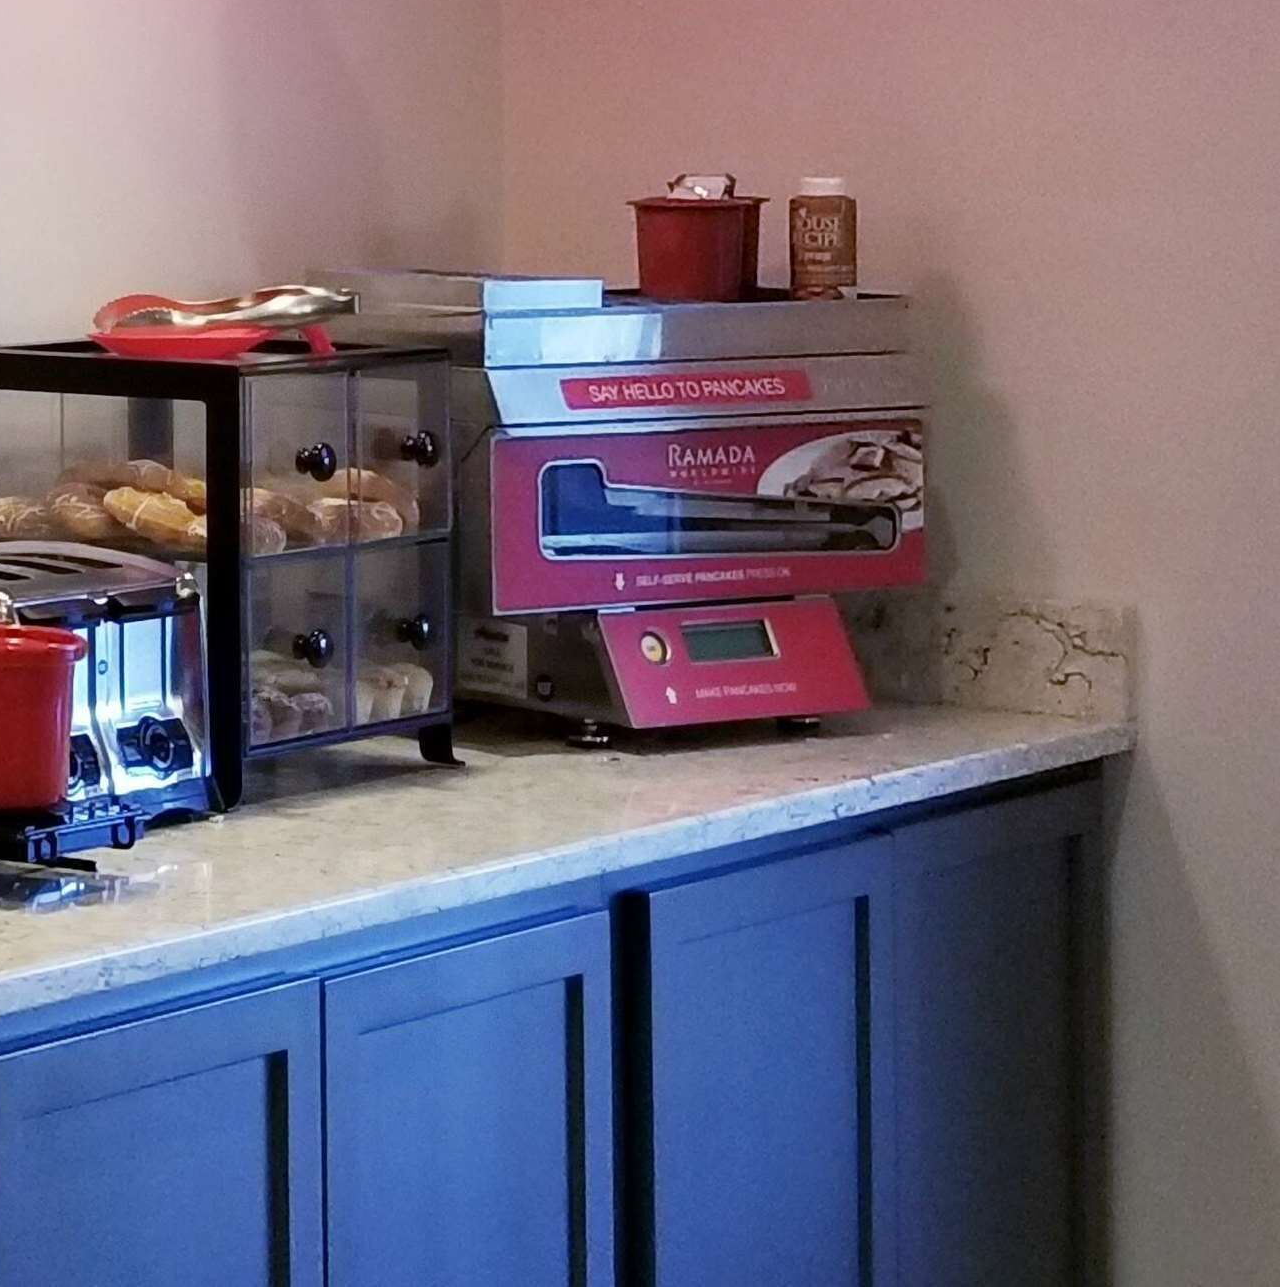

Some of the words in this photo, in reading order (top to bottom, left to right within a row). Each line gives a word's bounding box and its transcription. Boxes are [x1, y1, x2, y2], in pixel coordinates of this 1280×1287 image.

[588, 383, 619, 403] SAY
[623, 381, 675, 401] HELLO
[677, 380, 700, 398] TO
[702, 377, 786, 397] PANCAKES
[668, 443, 756, 467] RAMADA
[694, 567, 744, 582] PANCAKES
